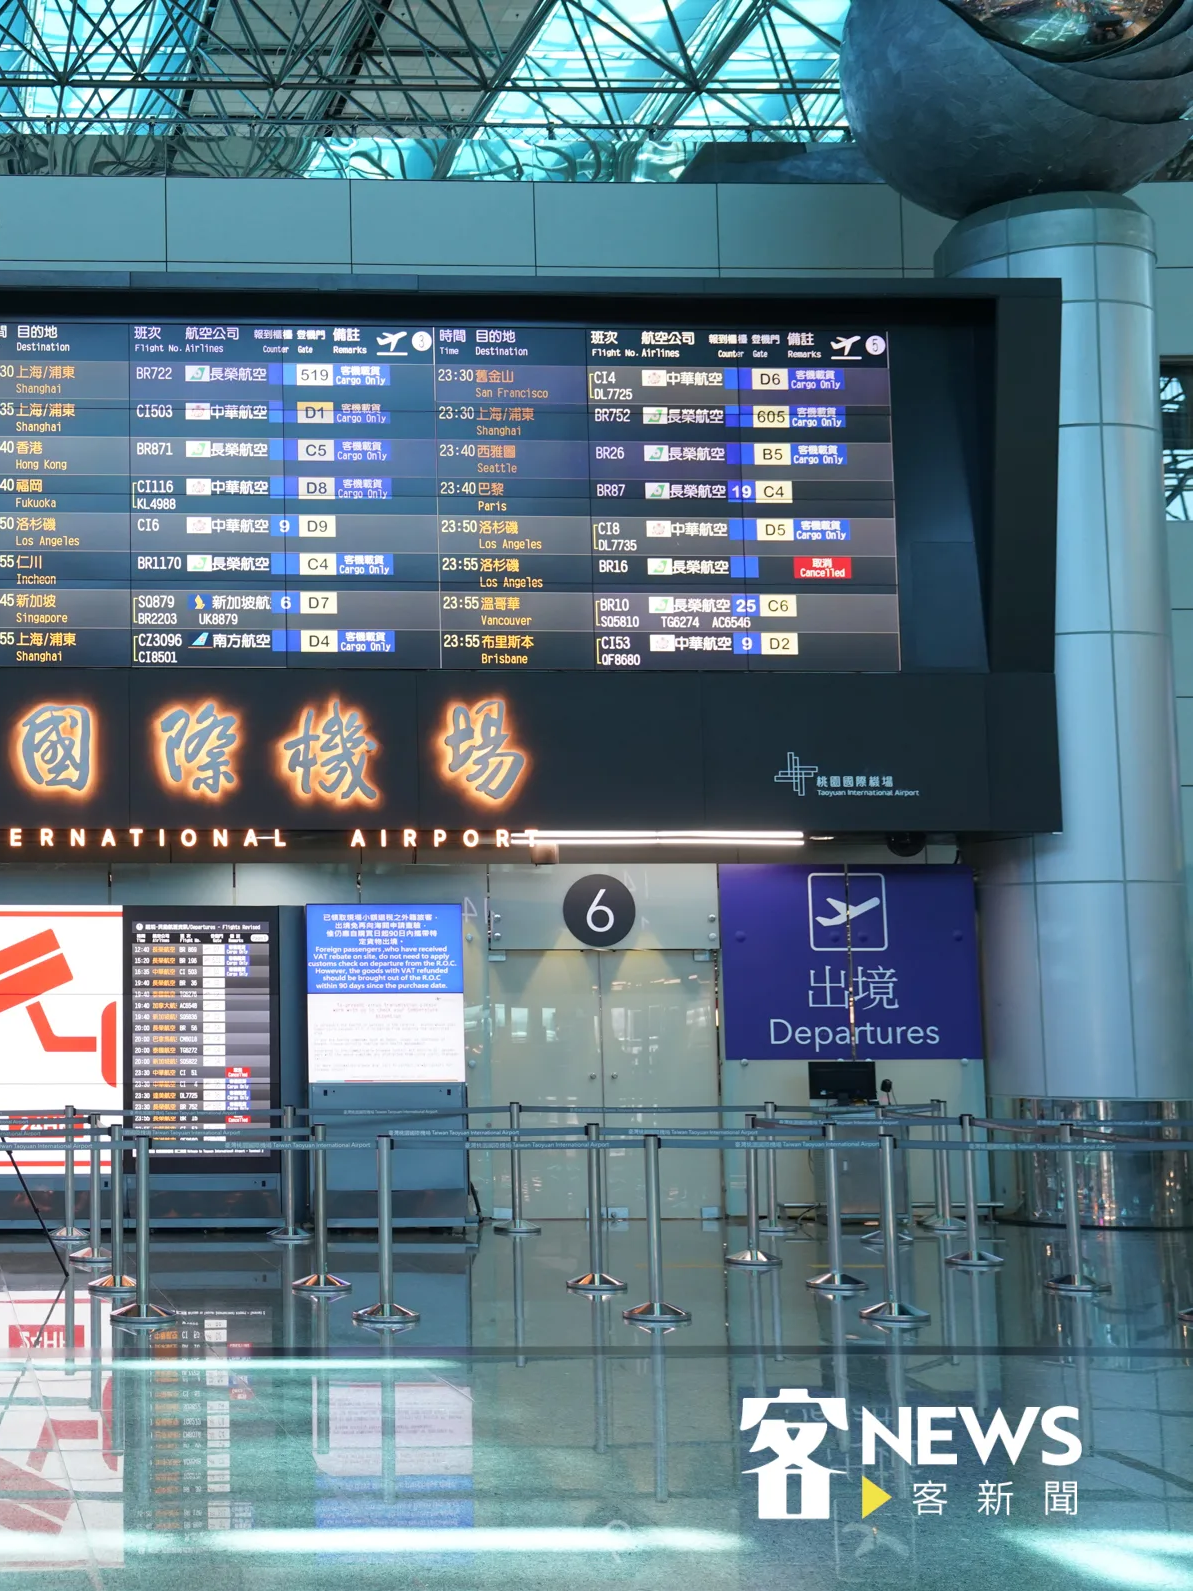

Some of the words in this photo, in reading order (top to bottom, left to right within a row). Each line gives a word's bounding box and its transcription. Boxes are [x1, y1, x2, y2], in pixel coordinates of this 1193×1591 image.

[301, 369, 329, 381] 519
[438, 369, 474, 381] 23:30
[594, 371, 616, 383] CI4
[16, 384, 62, 394] Shanghai
[476, 388, 492, 398] San
[497, 388, 548, 398] Francisco
[757, 410, 785, 423] 605
[596, 447, 624, 459] BR26
[16, 459, 39, 470] Hong
[44, 459, 67, 470] Kong
[478, 464, 517, 473] Seattle
[16, 498, 56, 508] Fukuoka
[478, 501, 507, 511] Paris
[16, 517, 56, 531] 洛杉磯
[137, 519, 159, 531] CI6
[16, 536, 33, 546] Los
[39, 536, 80, 547] Angeles
[812, 558, 832, 568] 取消
[800, 568, 846, 578] Cancelled
[443, 597, 479, 609] 23:55
[481, 597, 520, 610] 溫哥華
[736, 599, 756, 612] 25
[768, 600, 789, 612] C6
[16, 613, 68, 624] Singapore
[481, 615, 532, 626] Vancouver
[138, 652, 178, 663] CI8501
[481, 654, 528, 664] Brisbane
[816, 776, 893, 787] 桃園國際機場
[350, 829, 538, 848] AIRPORT
[586, 888, 615, 933] 6
[349, 982, 365, 990] days
[398, 982, 429, 990] purchase
[808, 965, 899, 1010] 出境
[769, 1018, 940, 1052] Departures
